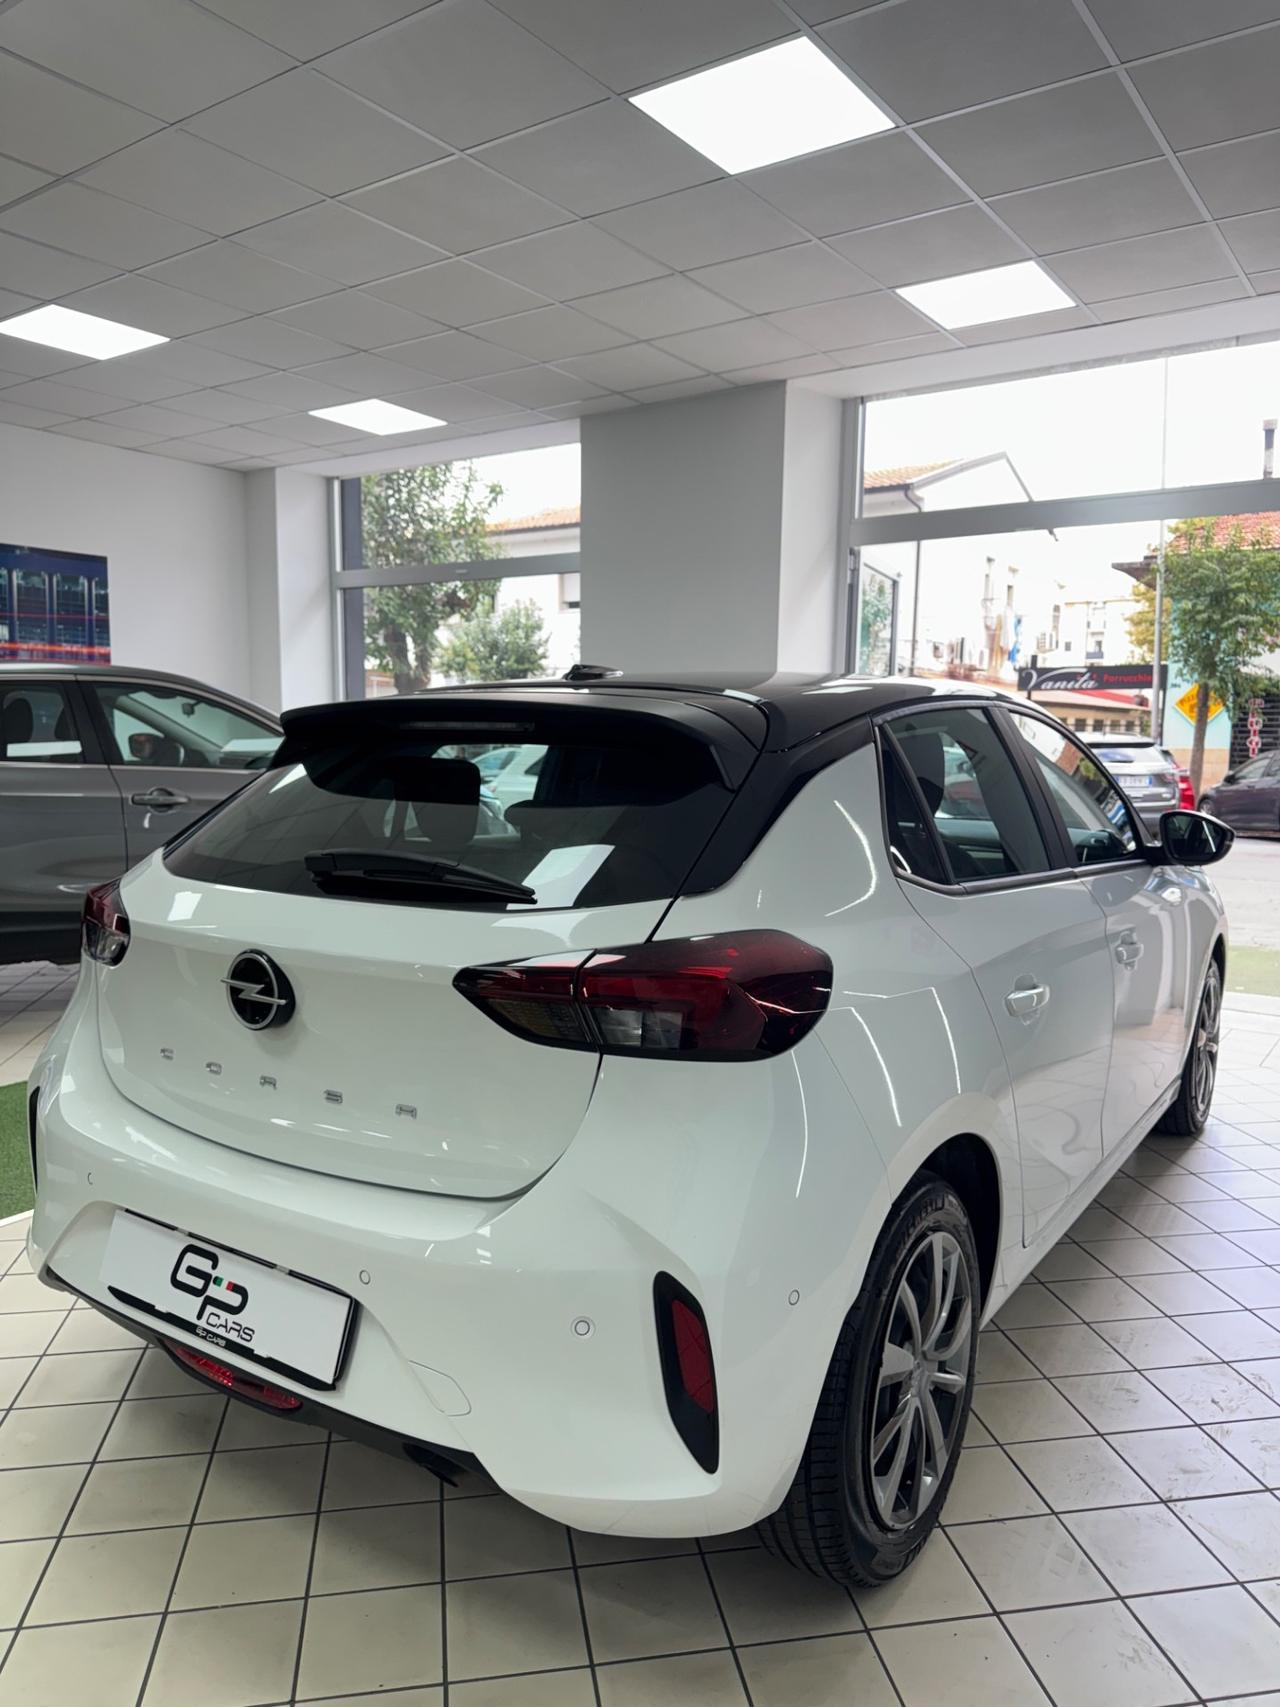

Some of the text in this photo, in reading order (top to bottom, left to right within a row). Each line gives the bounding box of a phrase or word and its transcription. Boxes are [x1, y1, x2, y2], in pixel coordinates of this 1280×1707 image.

[160, 1048, 417, 1119] CORSA
[170, 1244, 249, 1320] GP
[206, 1312, 255, 1342] CARS
